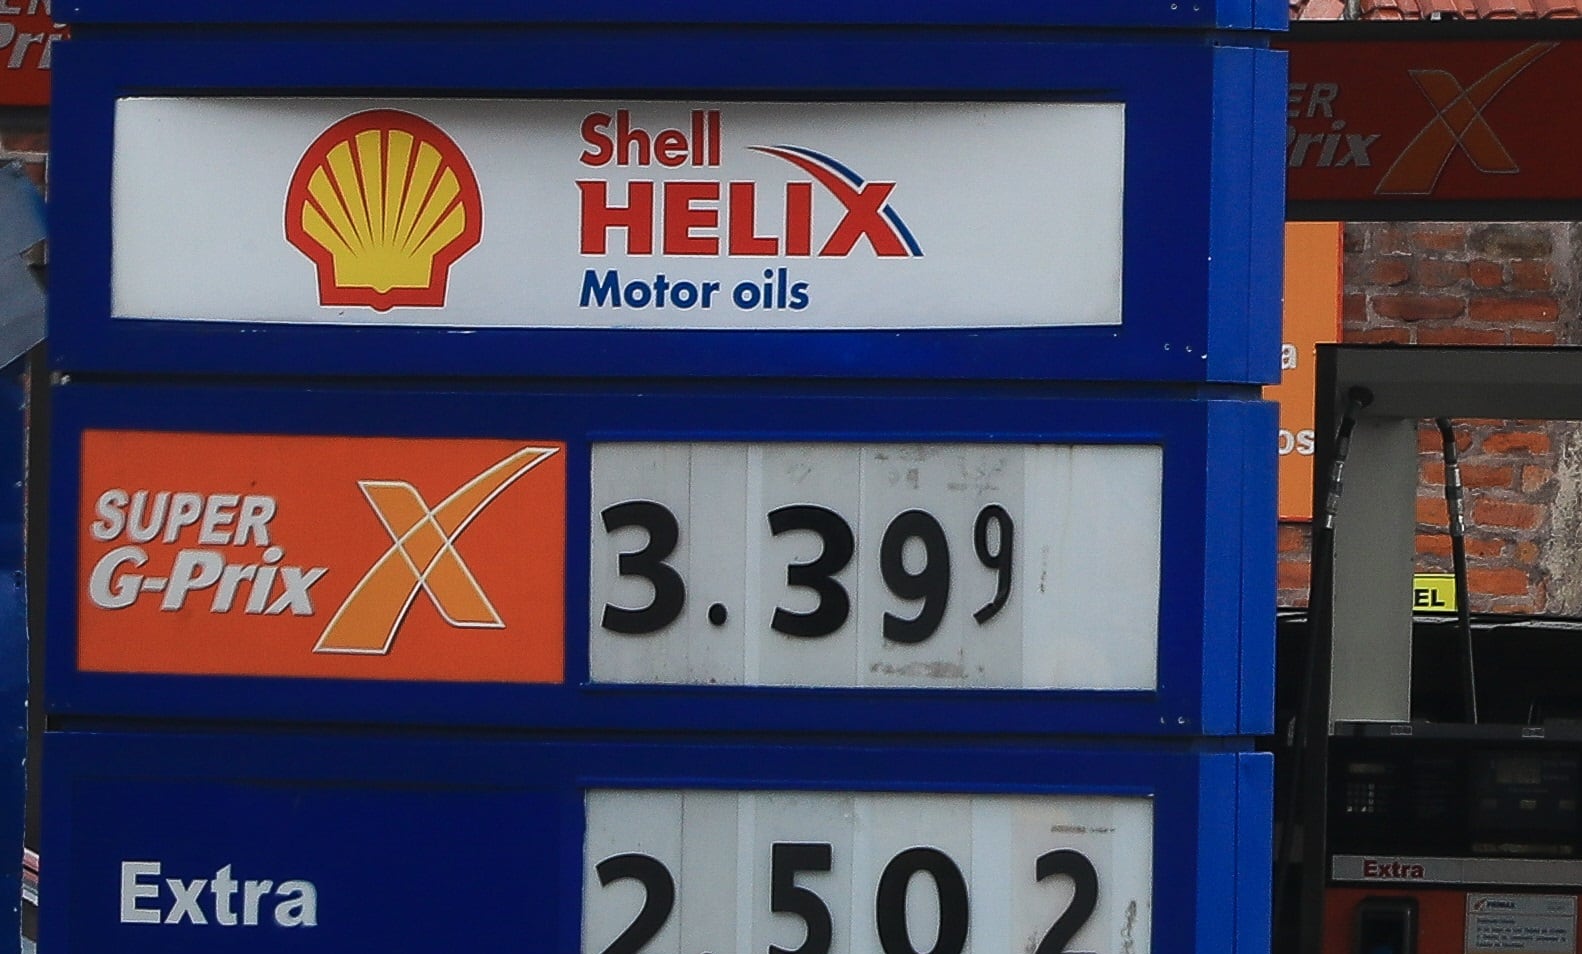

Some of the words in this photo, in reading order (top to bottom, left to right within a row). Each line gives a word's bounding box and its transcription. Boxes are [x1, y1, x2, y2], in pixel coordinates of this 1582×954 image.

[580, 109, 721, 167] Shell
[576, 178, 918, 257] HELIX
[579, 268, 720, 310] Motor
[733, 267, 811, 311] oils
[89, 488, 279, 548] SUPER
[88, 544, 329, 617] G-Prix
[1413, 588, 1446, 607] EL
[119, 860, 319, 928] Extra
[1363, 858, 1426, 880] Extra
